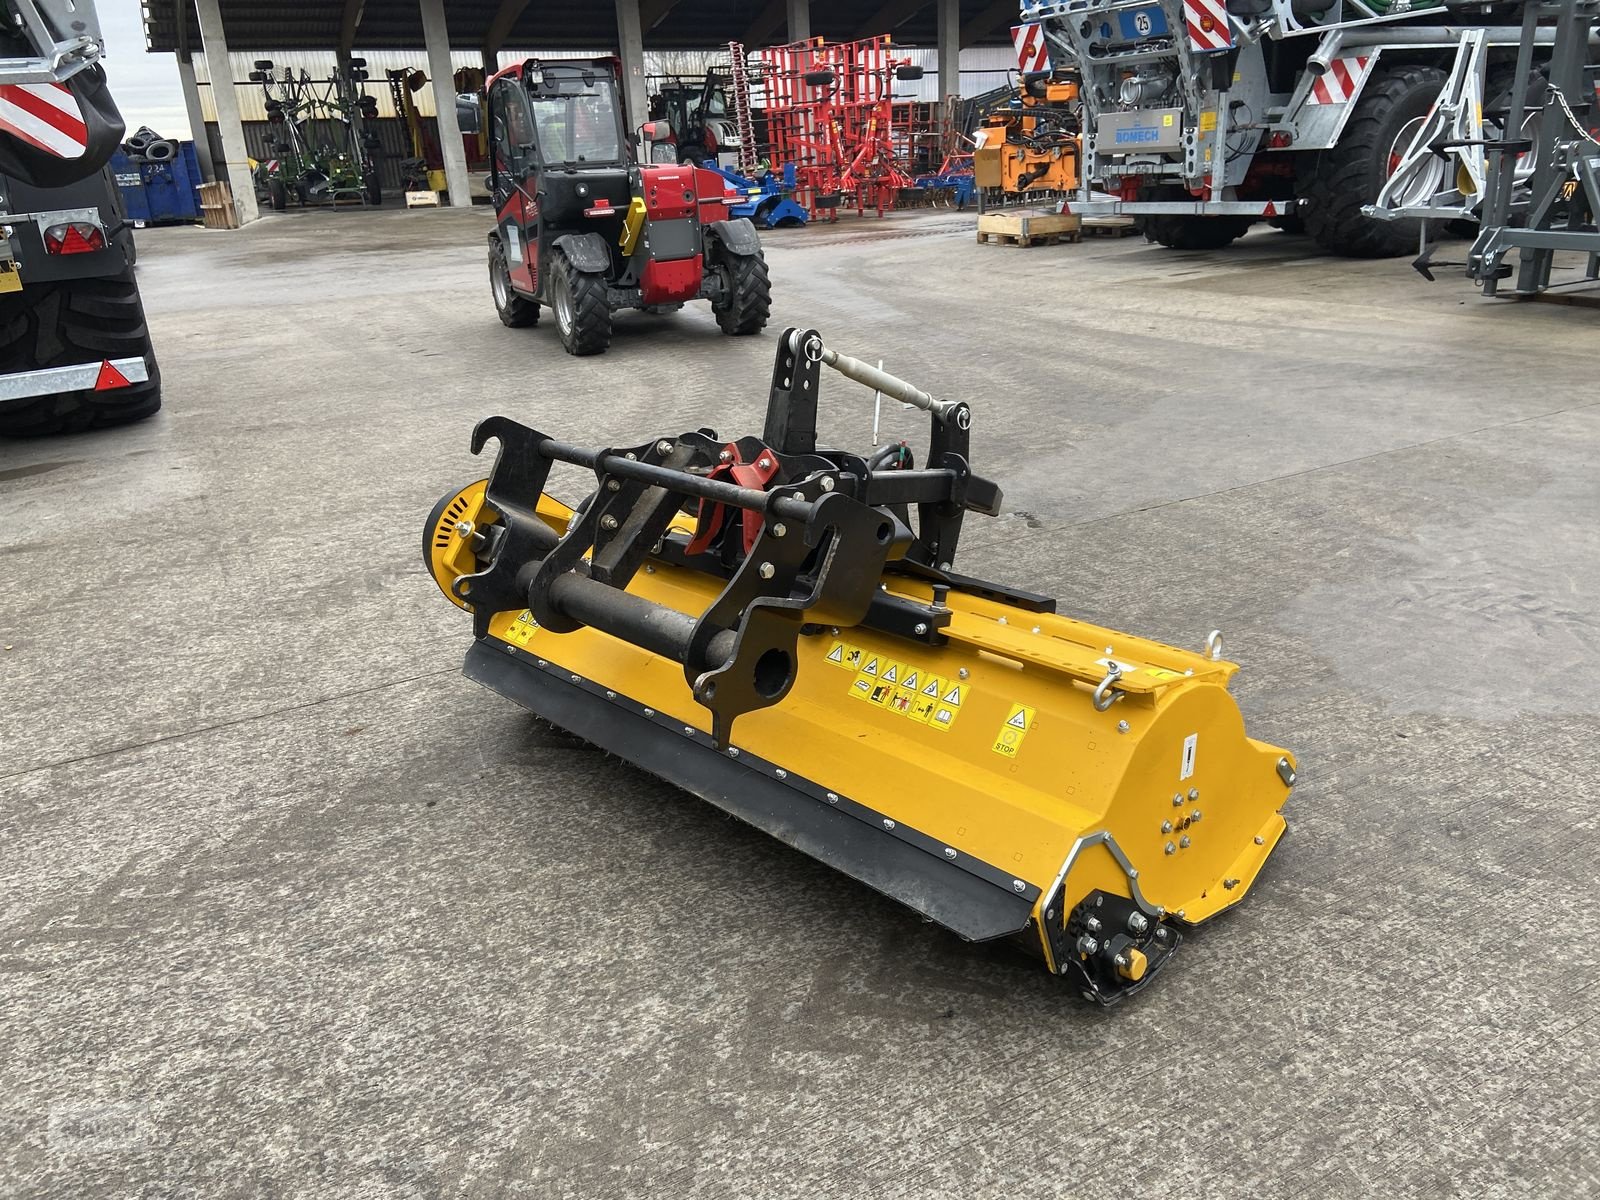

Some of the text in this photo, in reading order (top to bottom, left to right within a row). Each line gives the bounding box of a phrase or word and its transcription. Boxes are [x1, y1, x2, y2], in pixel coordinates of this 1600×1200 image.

[1137, 16, 1149, 31] 25
[1115, 130, 1159, 144] BOMECH
[995, 743, 1015, 754] STOP
